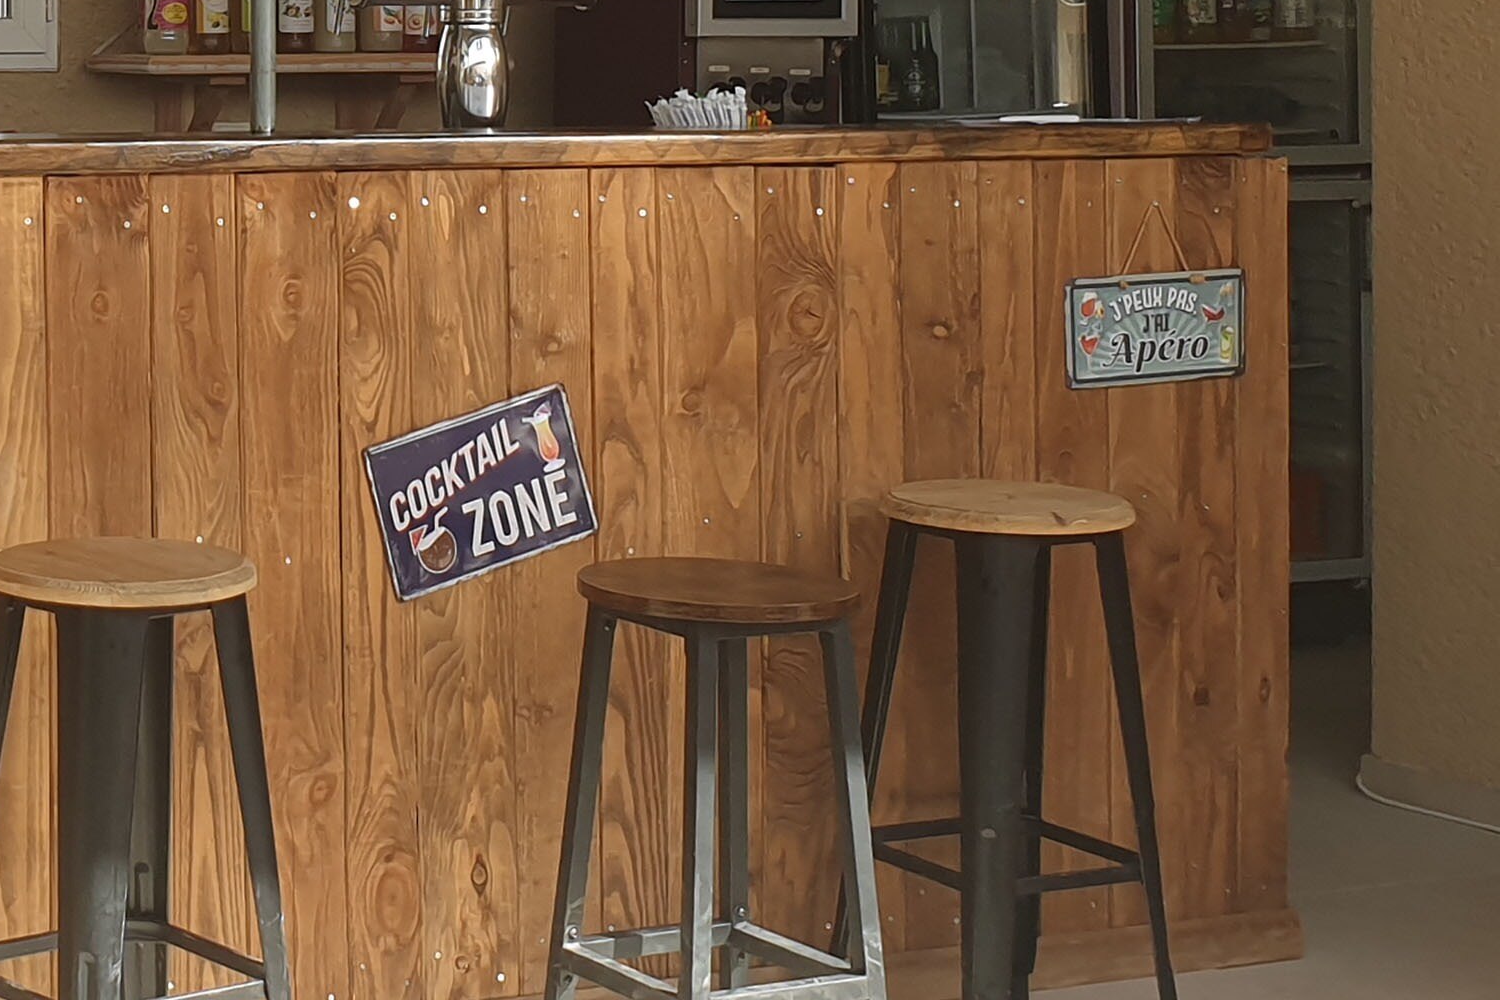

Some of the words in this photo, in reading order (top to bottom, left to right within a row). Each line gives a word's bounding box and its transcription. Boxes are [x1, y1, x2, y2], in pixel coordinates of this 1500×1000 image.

[1109, 287, 1162, 322] J'PEUX
[1142, 312, 1170, 334] J'AI
[1102, 329, 1209, 373] Apéro
[389, 418, 519, 532] COCKTAIL
[462, 470, 578, 556] ZONE
